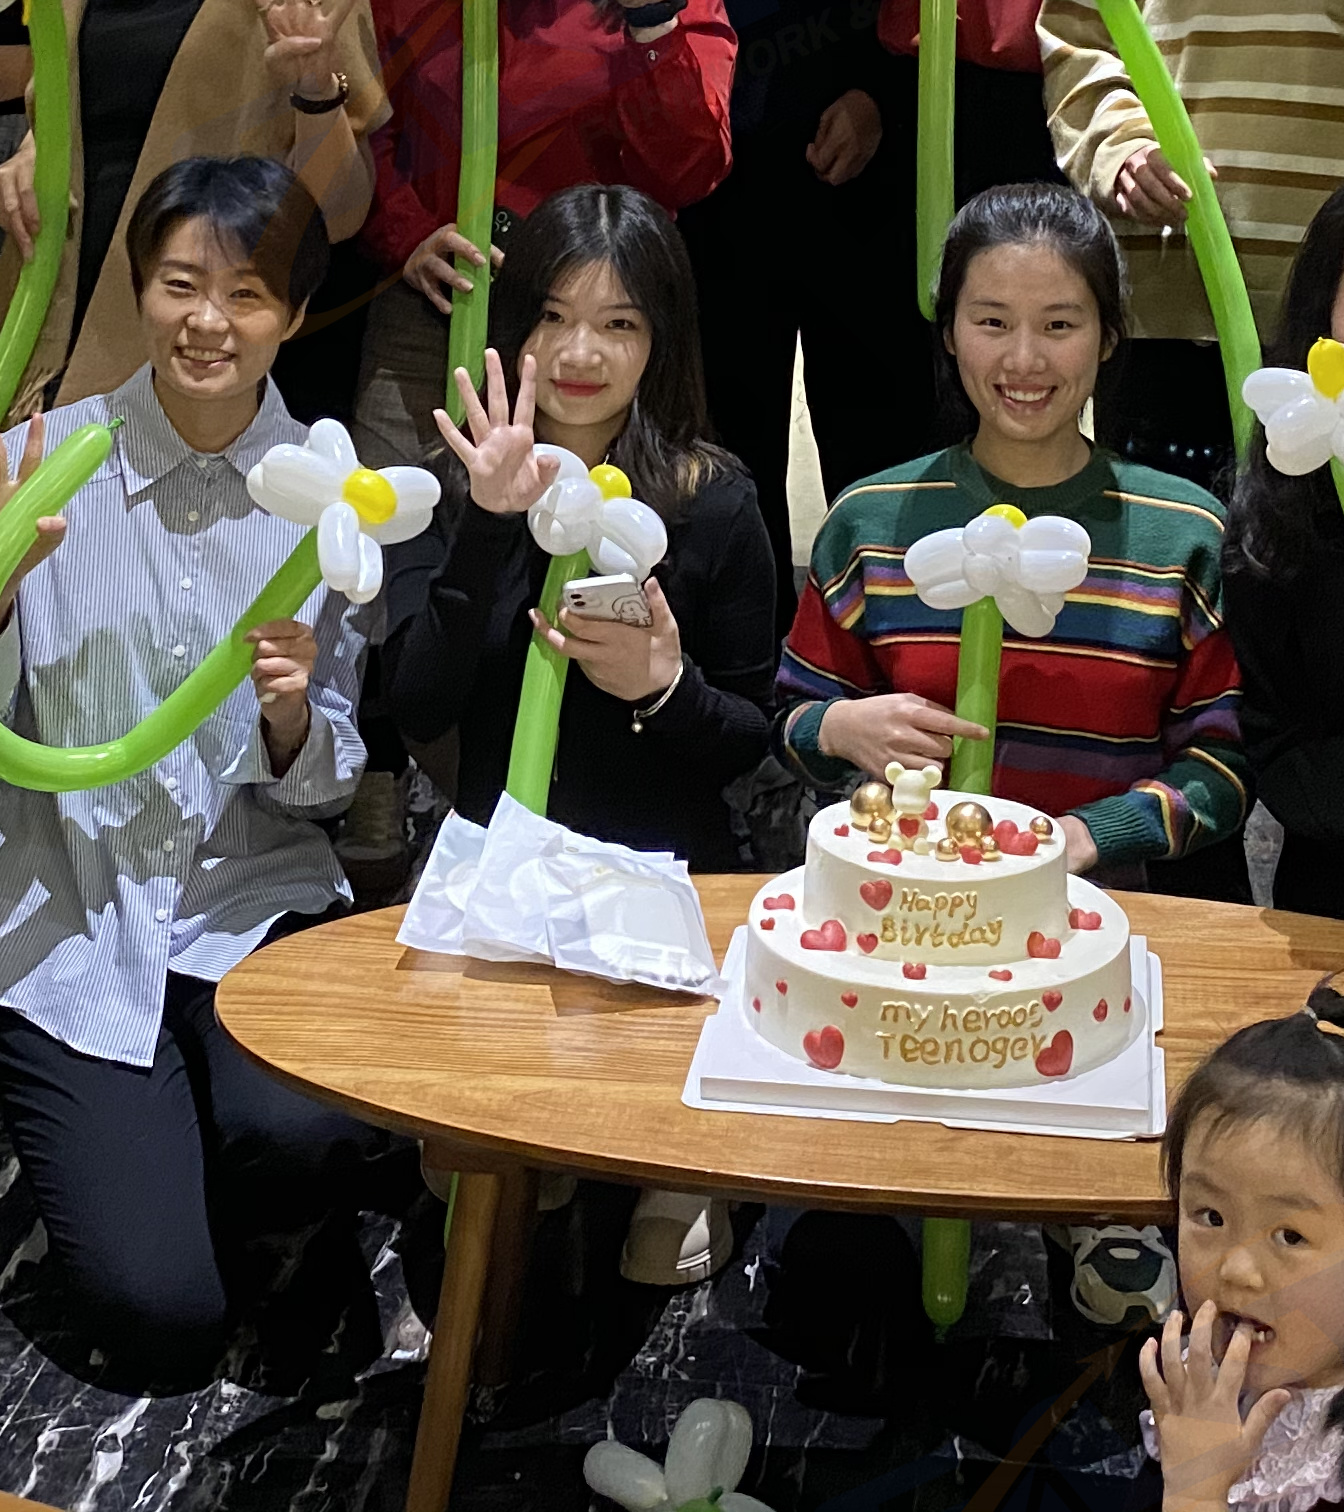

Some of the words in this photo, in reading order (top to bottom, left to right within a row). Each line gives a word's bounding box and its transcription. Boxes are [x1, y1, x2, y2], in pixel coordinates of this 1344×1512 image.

[899, 888, 977, 921] Happy
[880, 915, 1003, 948] Birtday
[880, 1001, 933, 1033] my
